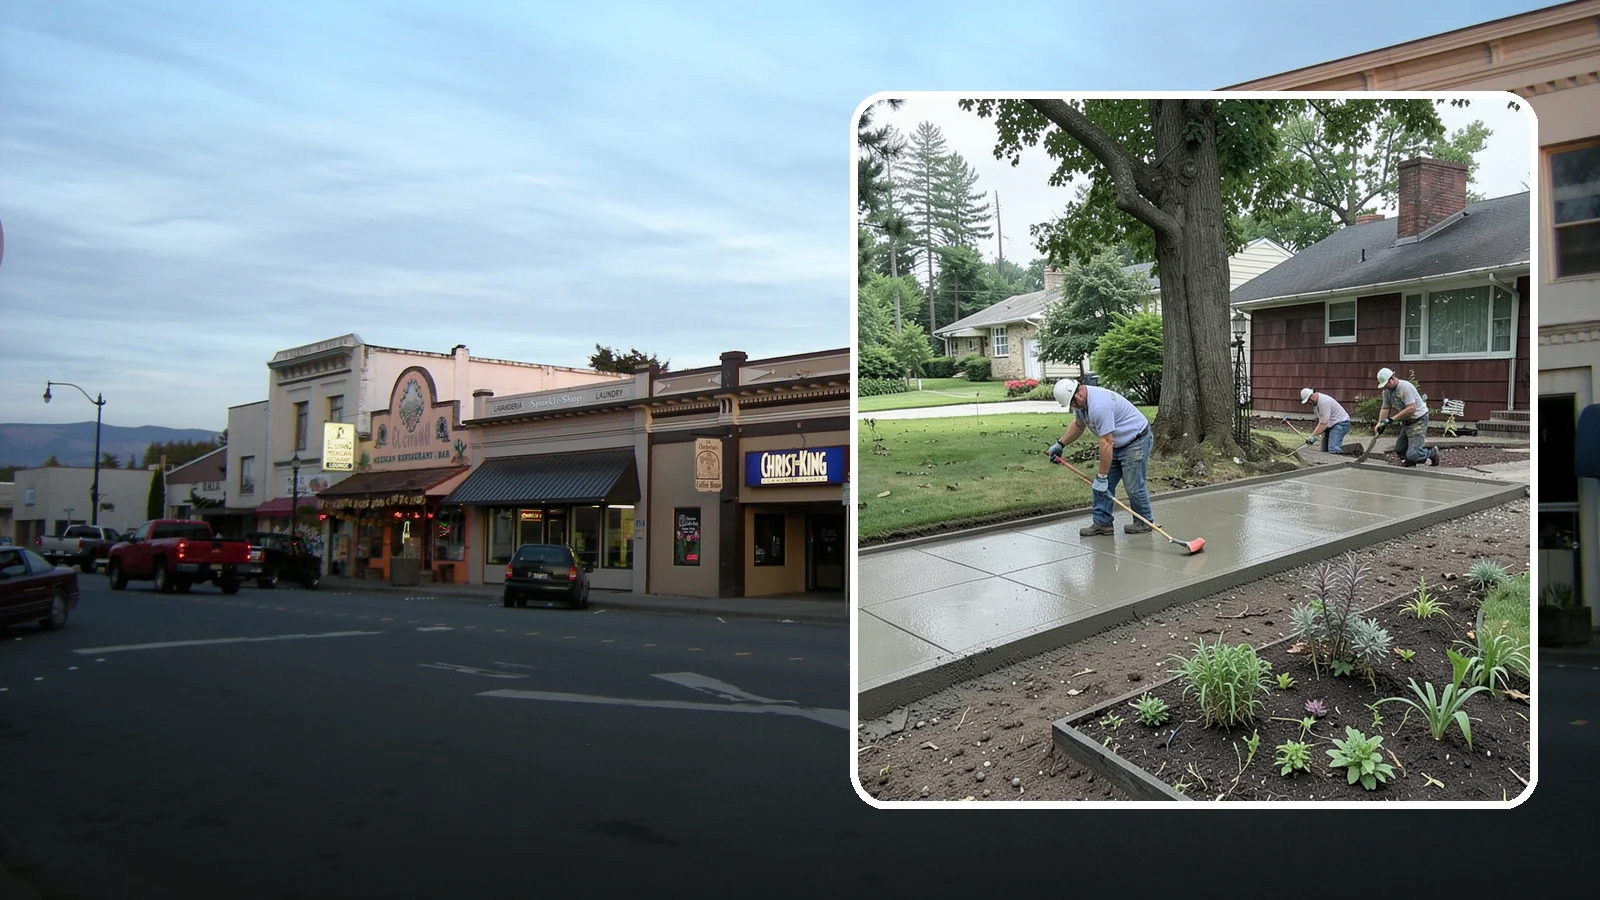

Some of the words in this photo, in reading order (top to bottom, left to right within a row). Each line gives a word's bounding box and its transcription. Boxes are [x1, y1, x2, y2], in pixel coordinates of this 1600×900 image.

[595, 389, 624, 400] LAUNDRY
[493, 402, 523, 412] LAVANDERIA
[530, 398, 562, 410] Sparkle
[562, 394, 582, 405] Shop
[373, 455, 396, 464] MEXICAN
[397, 451, 434, 463] RESTAURANT
[437, 450, 450, 459] BAR
[761, 452, 797, 478] CHRIST
[799, 450, 827, 476] KING
